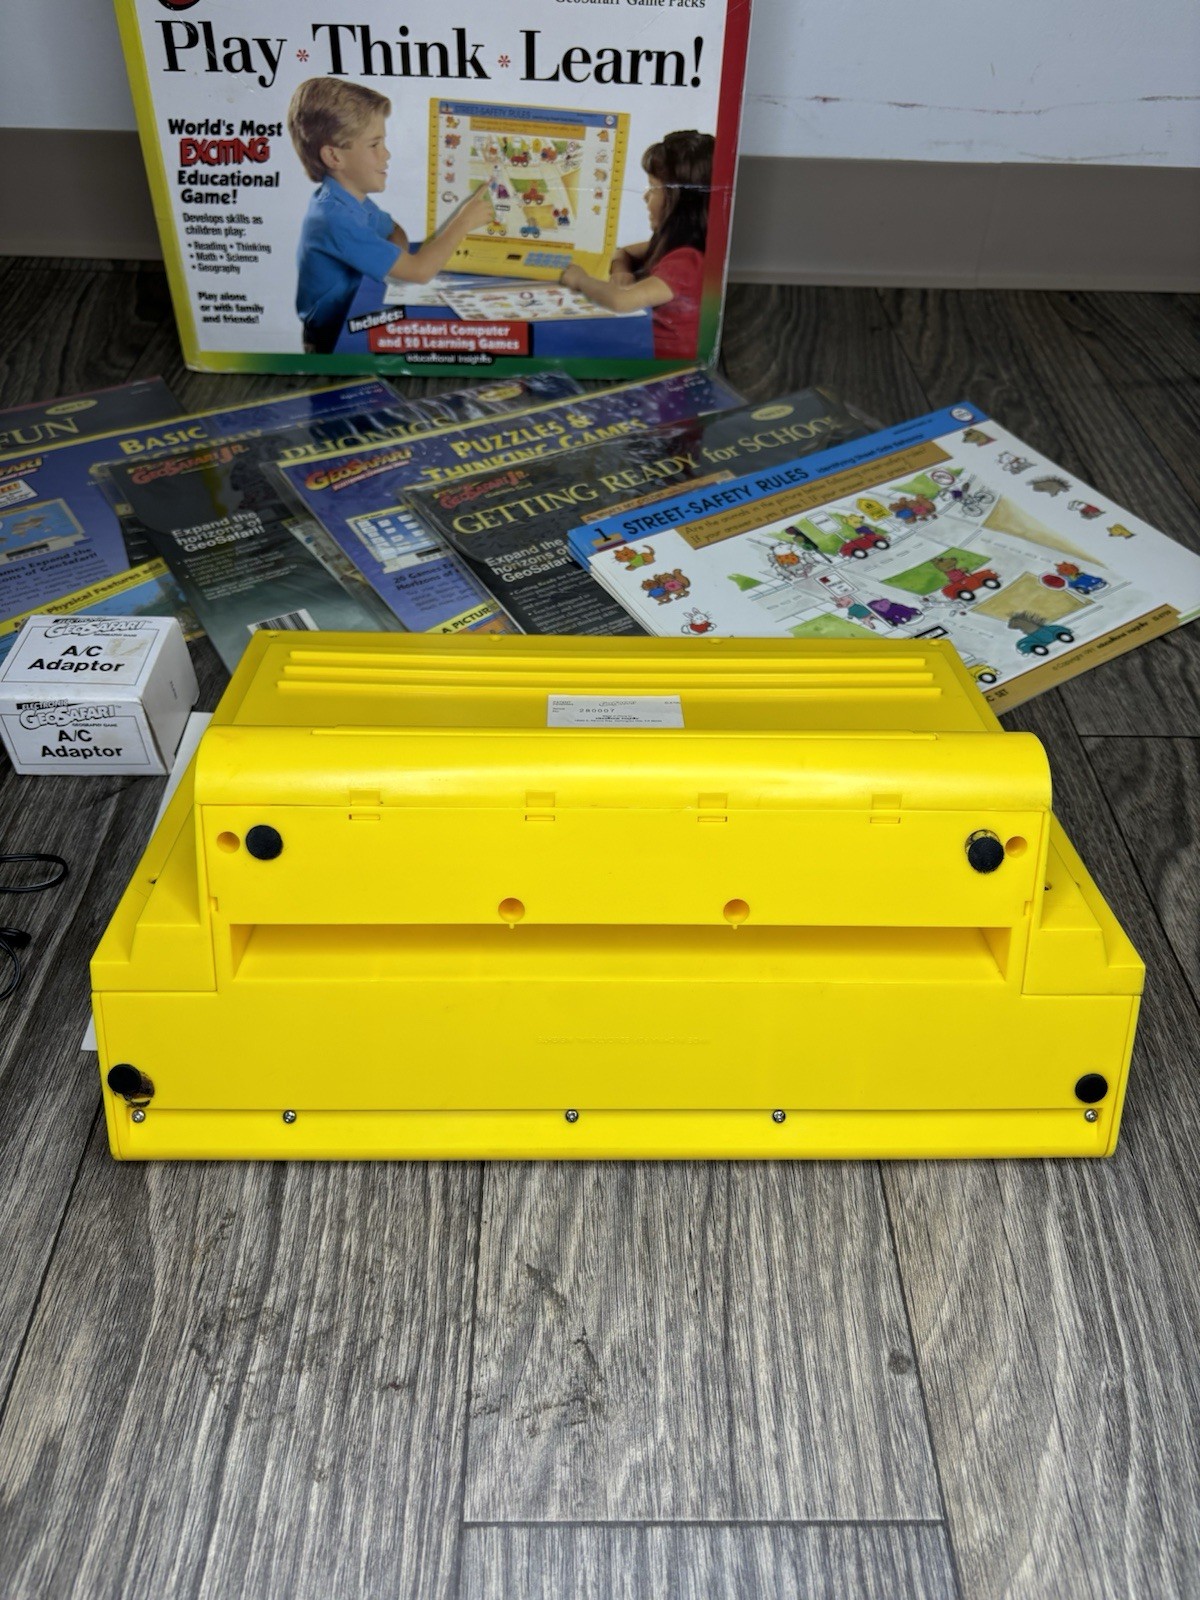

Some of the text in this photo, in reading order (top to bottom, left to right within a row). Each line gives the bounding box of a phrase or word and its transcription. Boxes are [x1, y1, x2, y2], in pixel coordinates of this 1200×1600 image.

[155, 20, 704, 88] Play Think Learn!
[168, 118, 283, 137] World's Most
[179, 137, 270, 166] EXCITING
[178, 170, 280, 187] Educational
[181, 188, 237, 205] Game!
[183, 212, 263, 225] Develops skills as
[185, 225, 247, 238] children play:
[193, 241, 272, 254] Reading Thinking
[196, 253, 259, 263] Math Science
[197, 264, 241, 274] Geography
[198, 292, 247, 302] Play alone
[214, 303, 234, 312] with
[235, 304, 264, 314] family
[202, 315, 260, 324] and friends!
[350, 308, 404, 332] Includes:
[386, 322, 510, 338] GeoSafari Computer
[377, 337, 402, 348] and
[422, 338, 476, 351] Learning
[479, 339, 520, 350] Games
[119, 426, 208, 455] BASIC
[451, 413, 595, 459] PUZZLES &
[453, 483, 599, 534] GETTING
[599, 453, 701, 493] READY
[702, 446, 741, 463] for
[594, 467, 809, 543] 1 STREET-SAFETY RULES
[171, 511, 258, 539] Expand the
[175, 517, 262, 546] horizons of
[685, 526, 704, 535] Are
[183, 525, 266, 553] GeoSafari!
[484, 538, 565, 568] Expand the
[491, 550, 555, 576] horizons
[46, 591, 94, 614] Physical
[95, 572, 141, 595] Features
[61, 645, 103, 658] A/C
[27, 658, 126, 673] Adaptor
[58, 729, 93, 742] A/C
[41, 745, 123, 760] Adaptor
